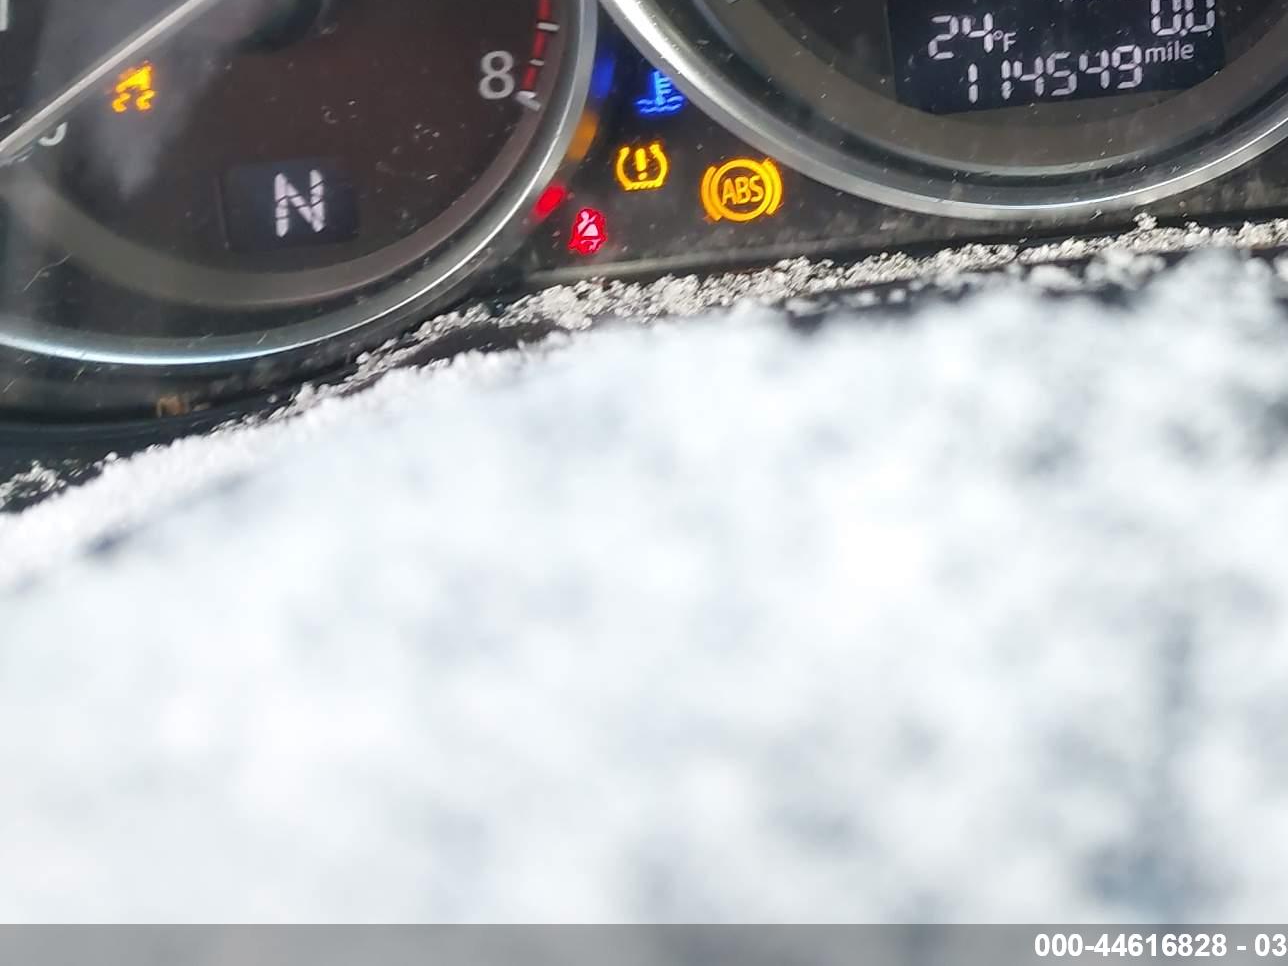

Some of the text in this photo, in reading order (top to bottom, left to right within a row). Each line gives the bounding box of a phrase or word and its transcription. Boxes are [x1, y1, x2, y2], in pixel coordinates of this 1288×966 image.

[478, 51, 515, 100] 8
[967, 40, 1195, 104] 114549 mile
[273, 168, 325, 238] N
[721, 175, 765, 206] ABS
